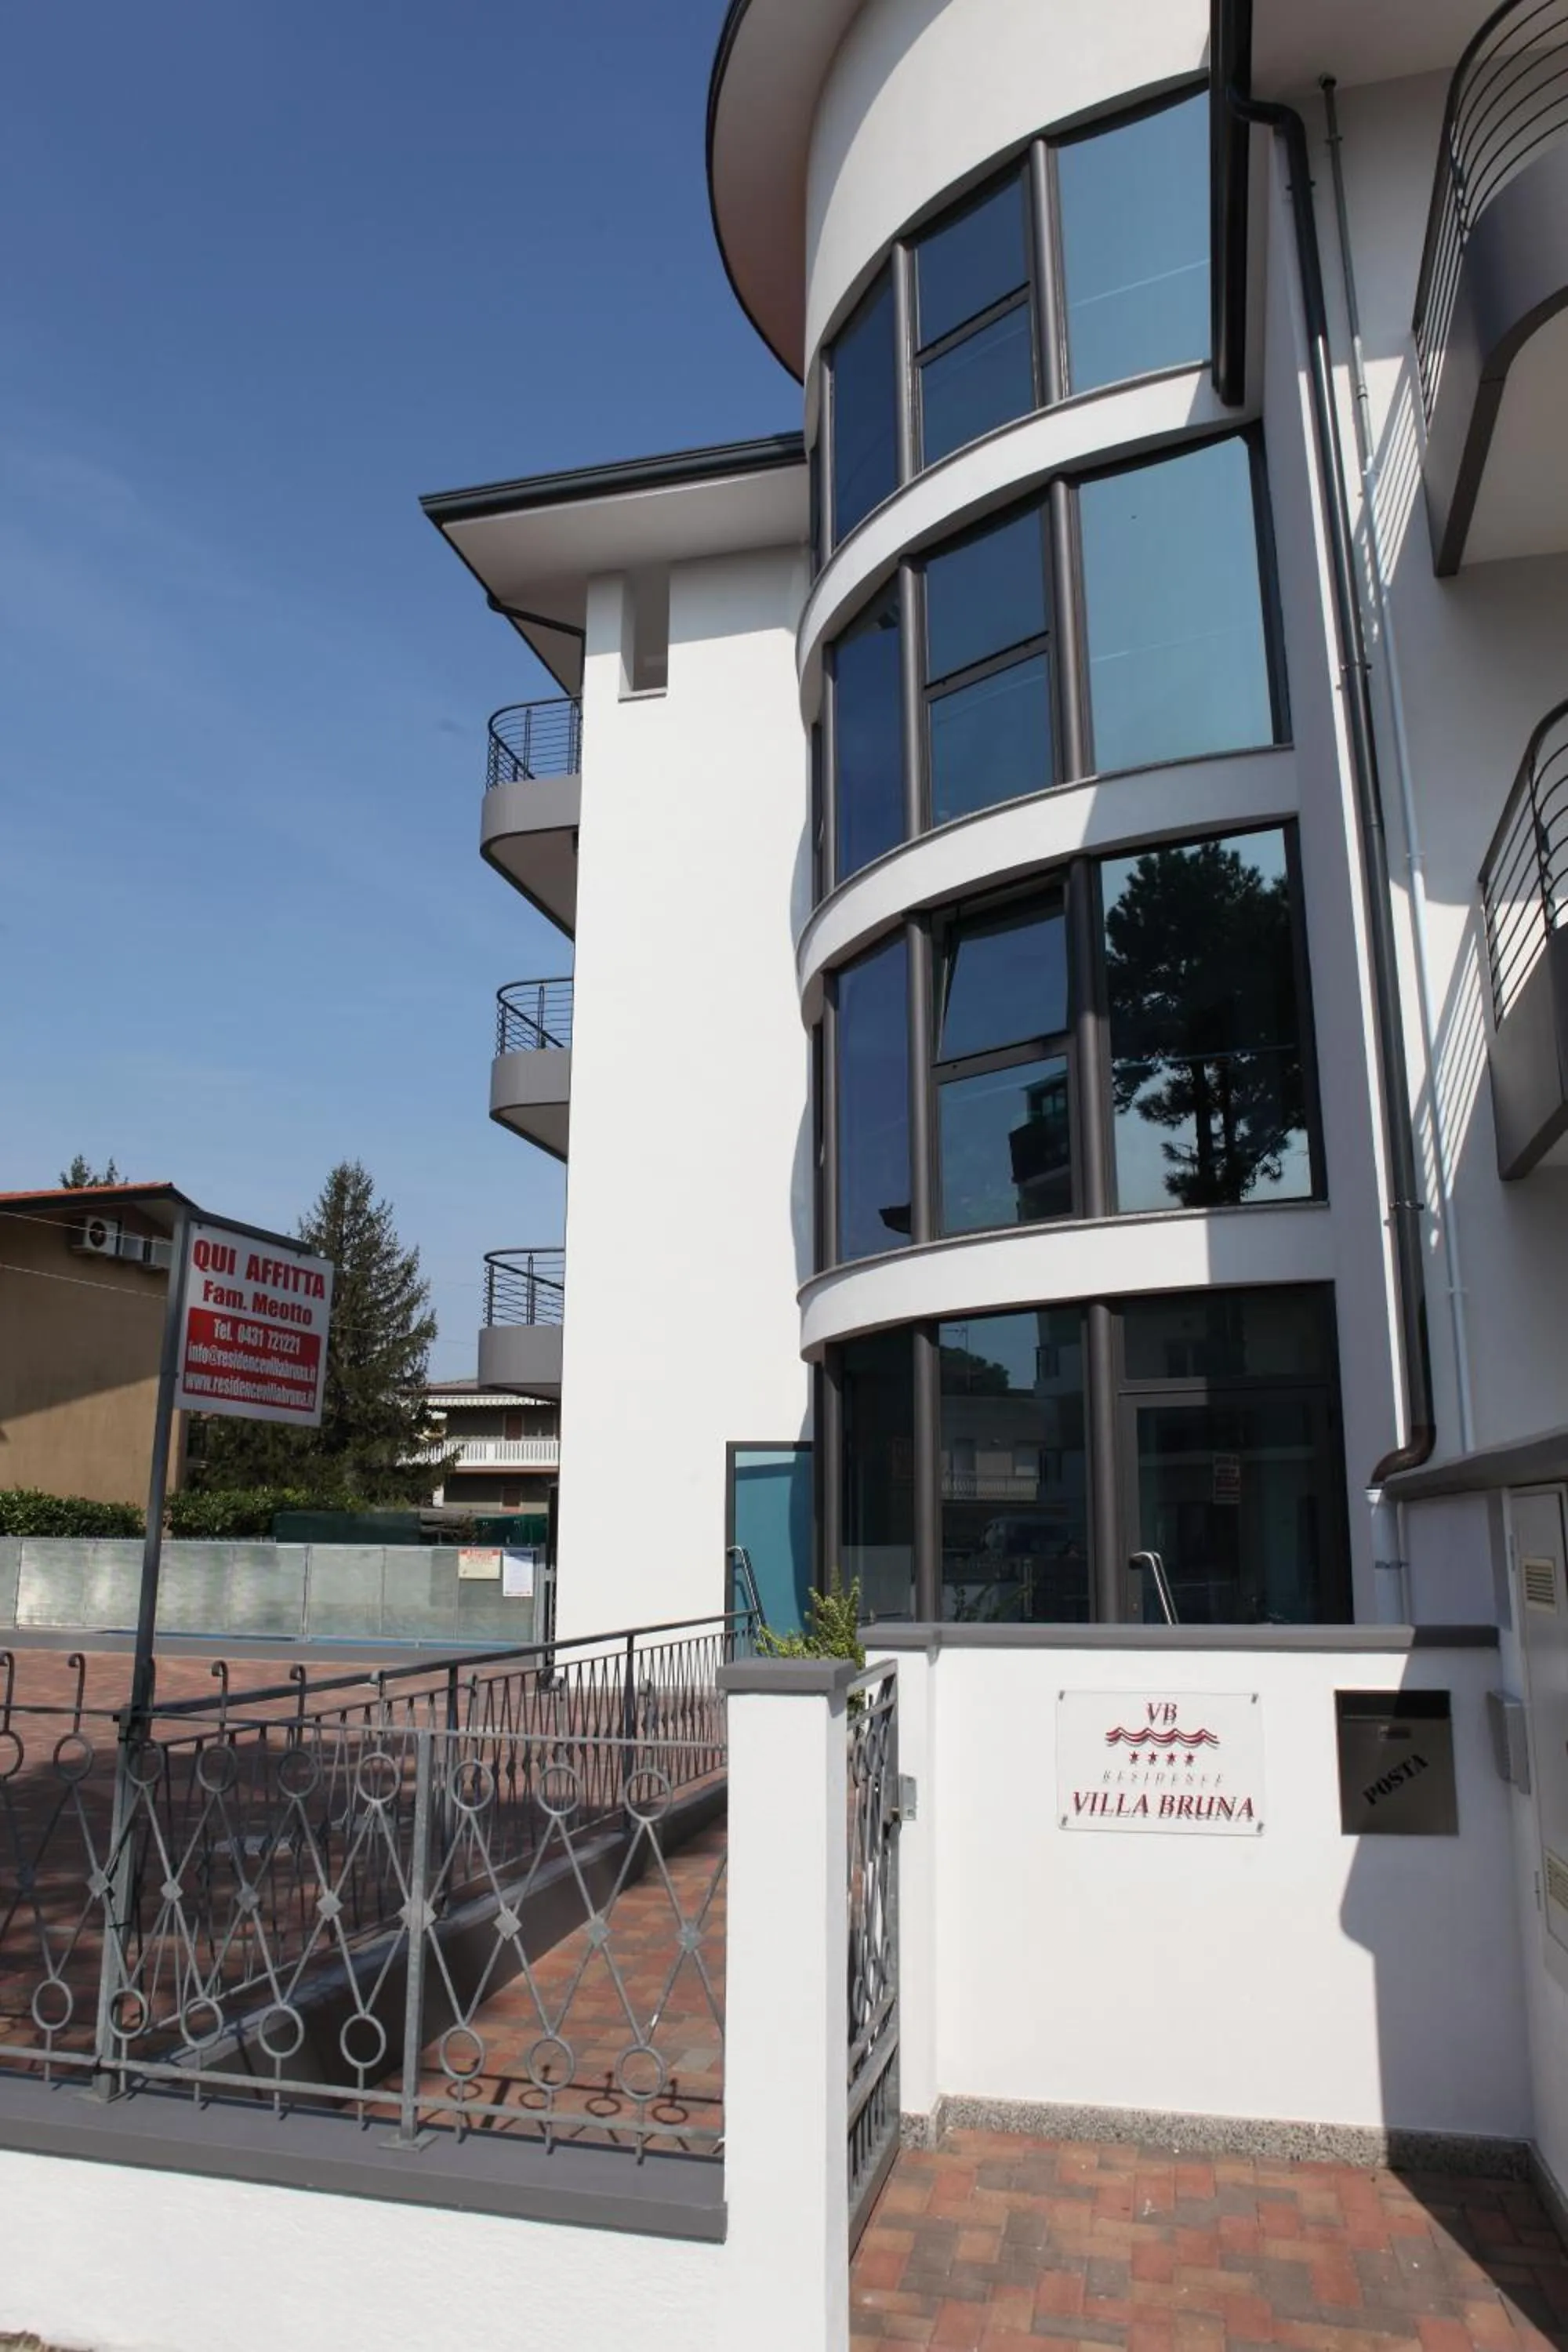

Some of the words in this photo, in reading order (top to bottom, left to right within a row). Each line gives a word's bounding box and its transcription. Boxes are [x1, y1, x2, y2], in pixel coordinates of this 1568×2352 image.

[194, 1240, 237, 1275] QUI
[246, 1254, 325, 1299] AFFITTA
[204, 1280, 247, 1310] Fam.
[252, 1292, 313, 1326] Meotto
[213, 1319, 233, 1342] Tel.
[238, 1323, 263, 1347] 0431
[267, 1332, 300, 1355] 721221
[1146, 1702, 1178, 1725] VB
[1102, 1769, 1224, 1788] RESIDENCE
[1362, 1754, 1429, 1806] POSTA
[1073, 1791, 1149, 1817] VILLA
[1158, 1794, 1255, 1822] BRUNA
